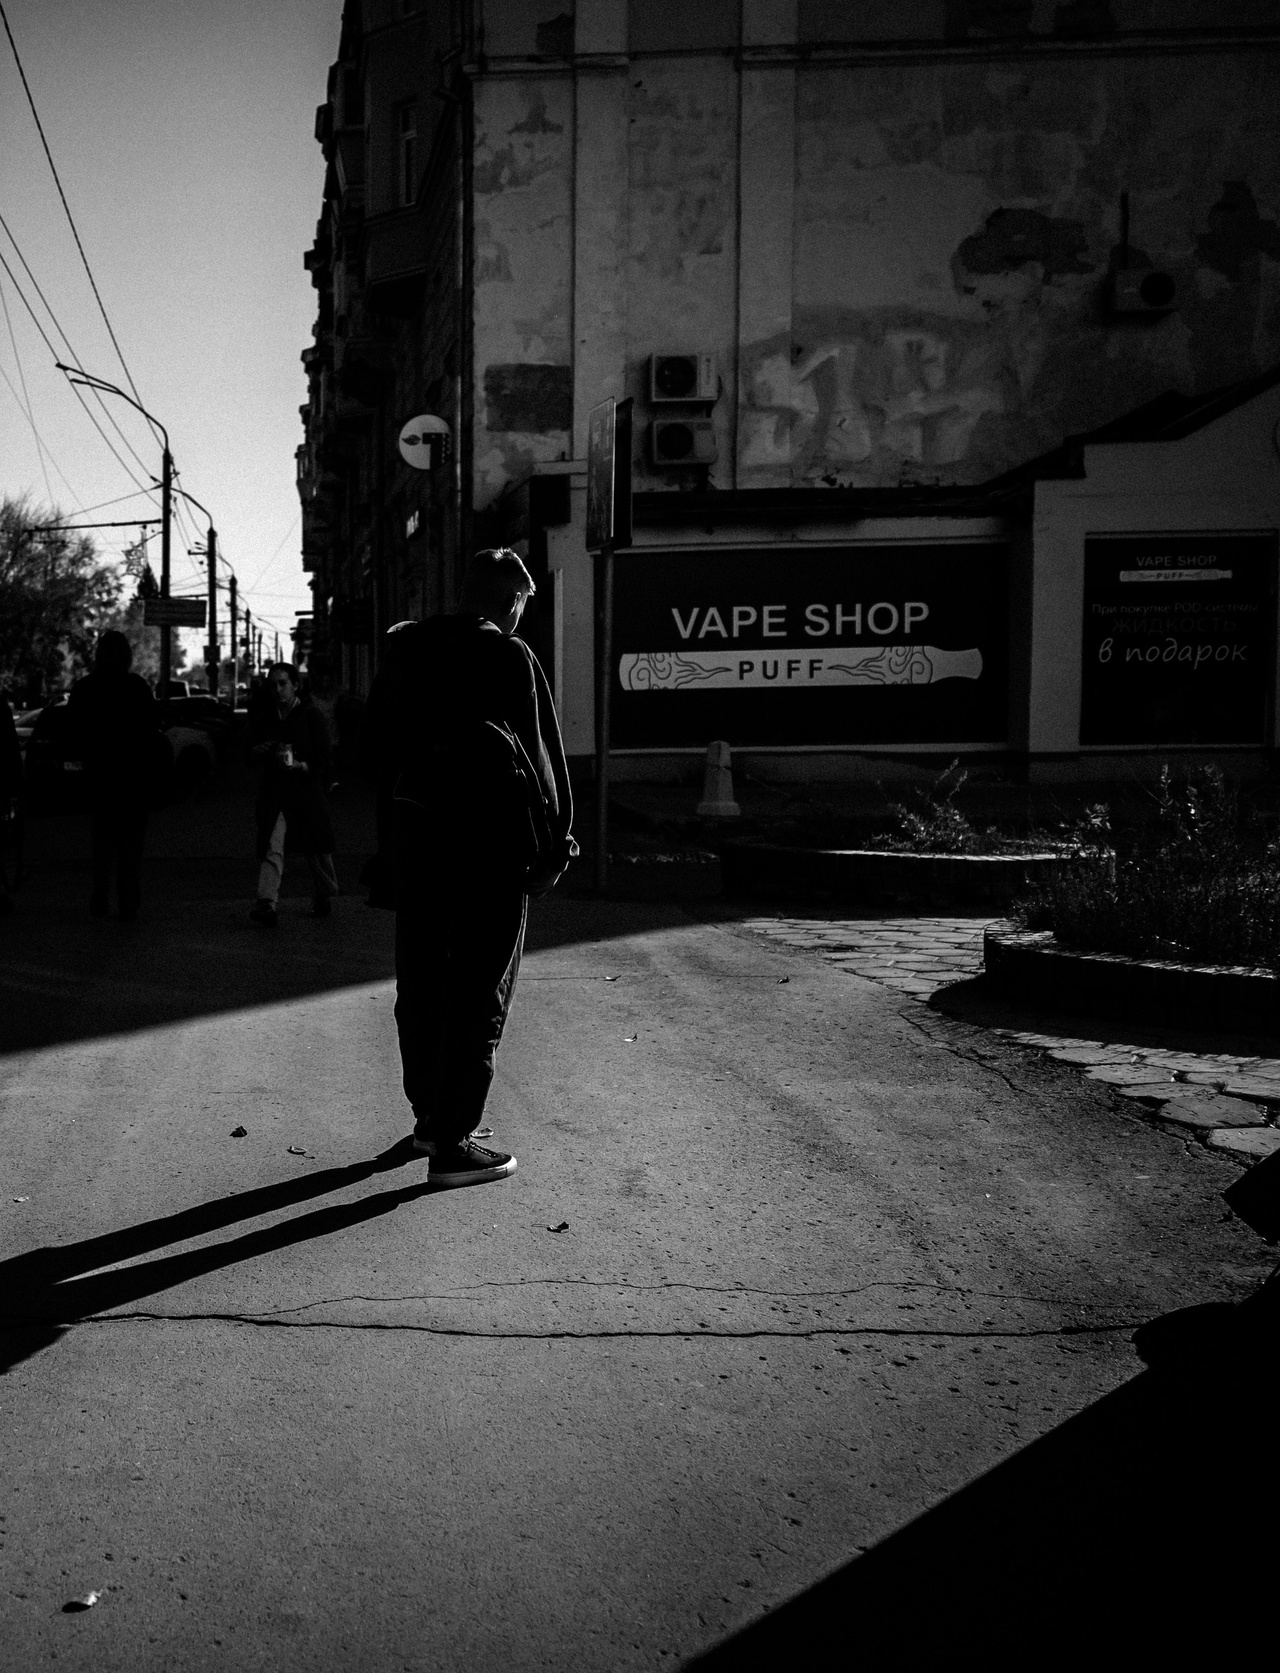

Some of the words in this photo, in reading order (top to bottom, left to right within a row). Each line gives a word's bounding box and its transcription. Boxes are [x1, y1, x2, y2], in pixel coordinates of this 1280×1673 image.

[1136, 556, 1172, 567] VAPE
[1177, 555, 1217, 566] SHOP
[671, 605, 787, 639] VAPE
[804, 602, 930, 635] SHOP
[1099, 637, 1113, 663] в
[1125, 637, 1249, 670] подарок
[739, 659, 824, 680] PUFF
